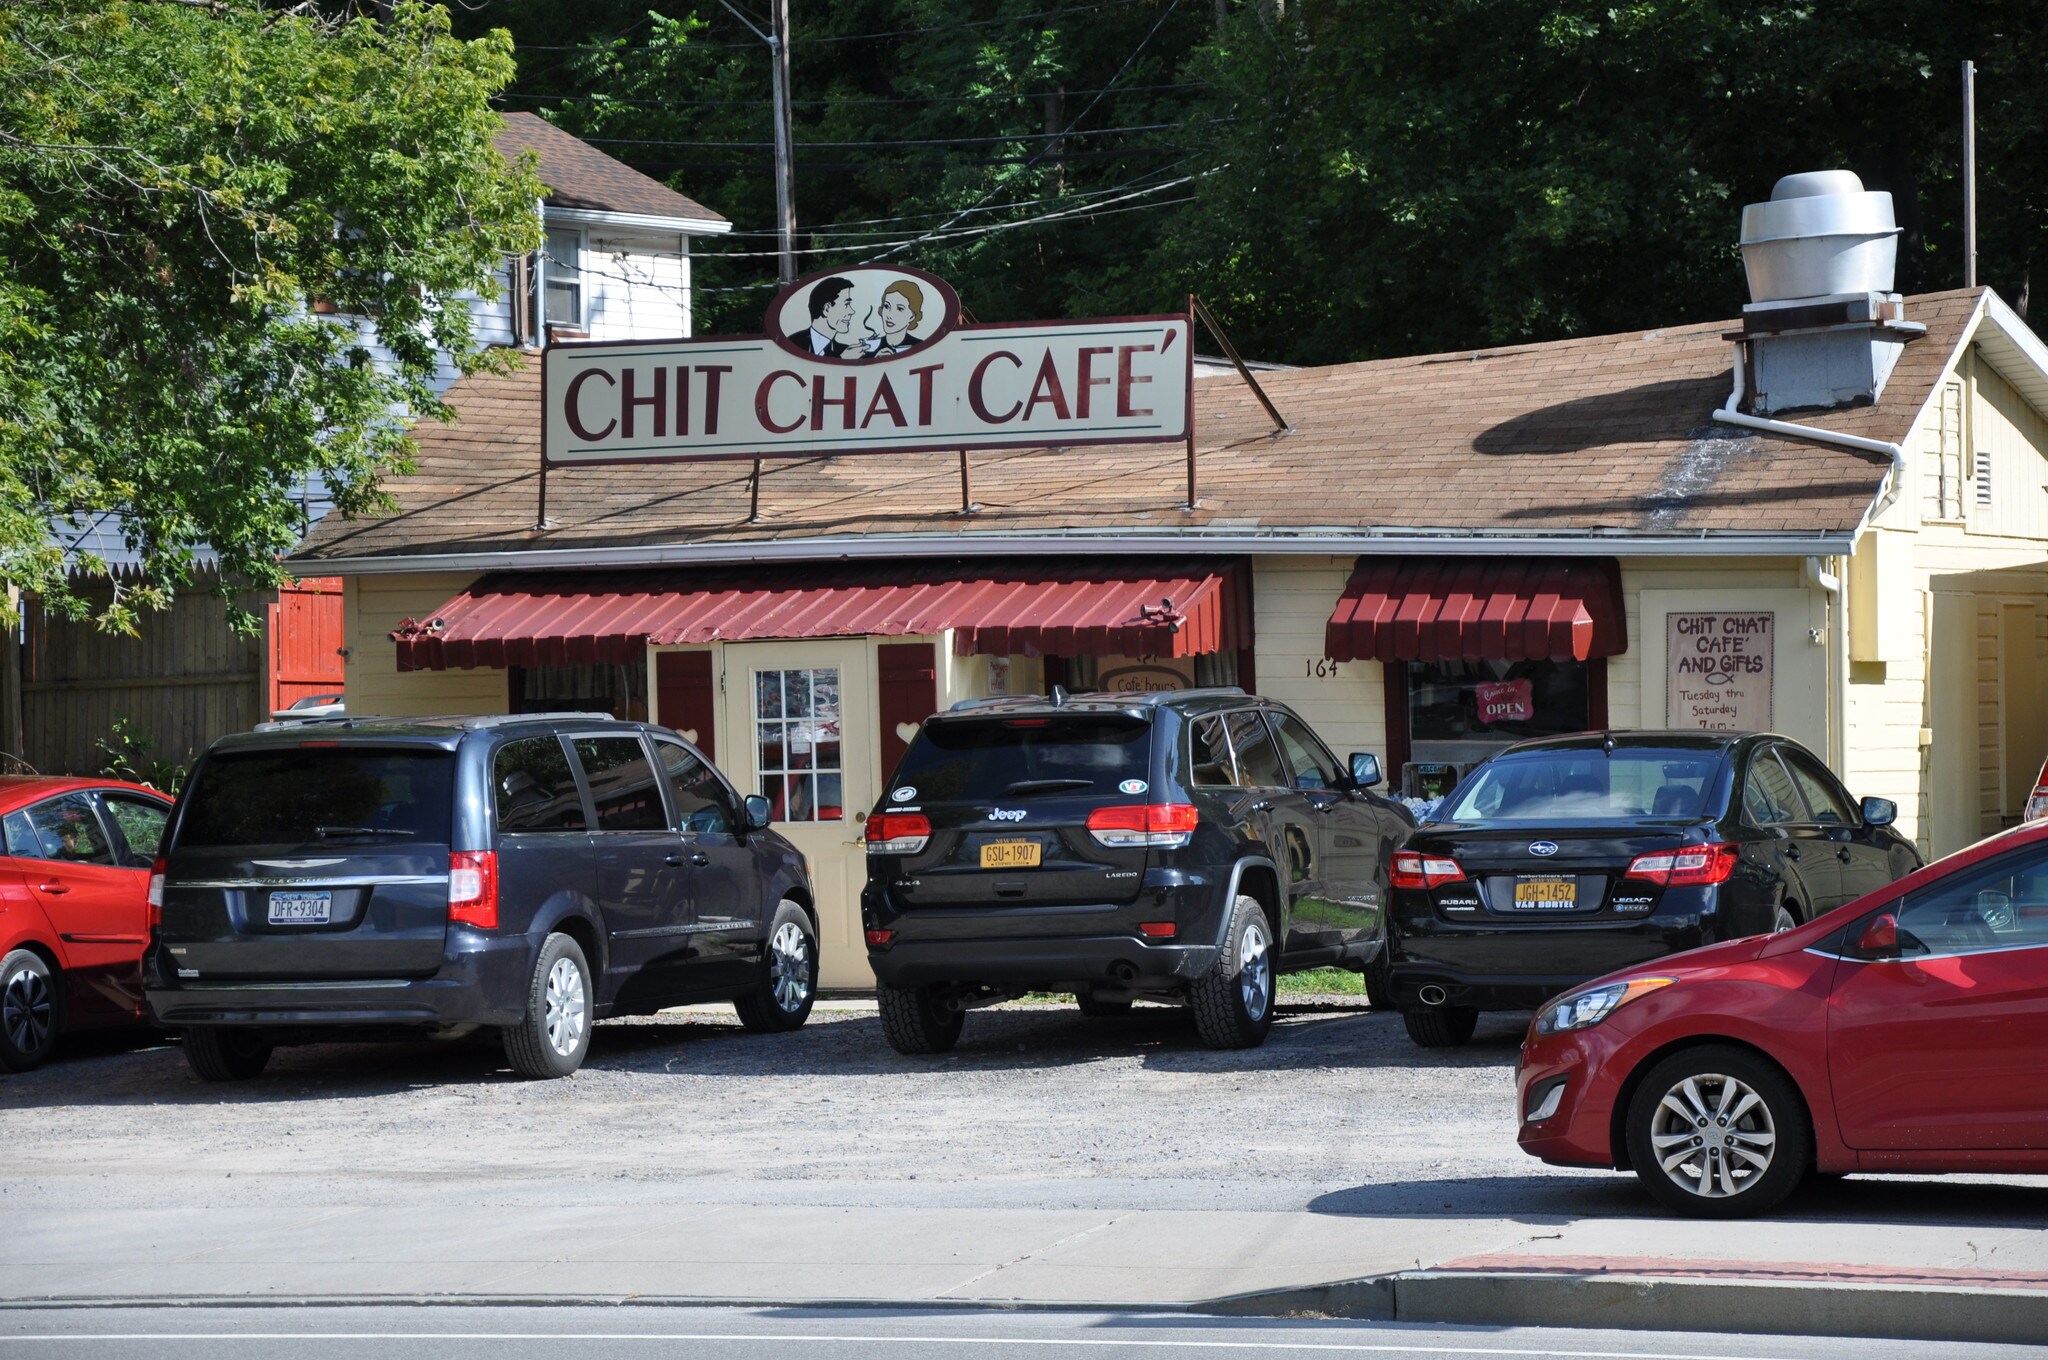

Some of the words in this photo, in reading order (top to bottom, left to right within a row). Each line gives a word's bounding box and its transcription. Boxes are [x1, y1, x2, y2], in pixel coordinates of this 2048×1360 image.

[564, 365, 733, 442] CHIT
[754, 363, 945, 434] CHAT
[1722, 616, 1771, 635] CHAT
[1306, 658, 1338, 679] 164
[1678, 656, 1716, 673] AND
[1145, 676, 1177, 692] hours
[1679, 689, 1720, 703] Tuesday
[1726, 689, 1745, 698] thru
[1486, 702, 1525, 715] OPEN
[1692, 704, 1738, 718] Saturday
[988, 807, 1027, 822] Jeep
[986, 845, 1005, 862] GSU
[1012, 844, 1035, 861] 1907
[1105, 871, 1138, 879] LAREDO
[1519, 884, 1539, 900] JGH
[1546, 884, 1572, 900] 1452
[274, 901, 293, 917] DFR
[300, 901, 324, 916] 9304
